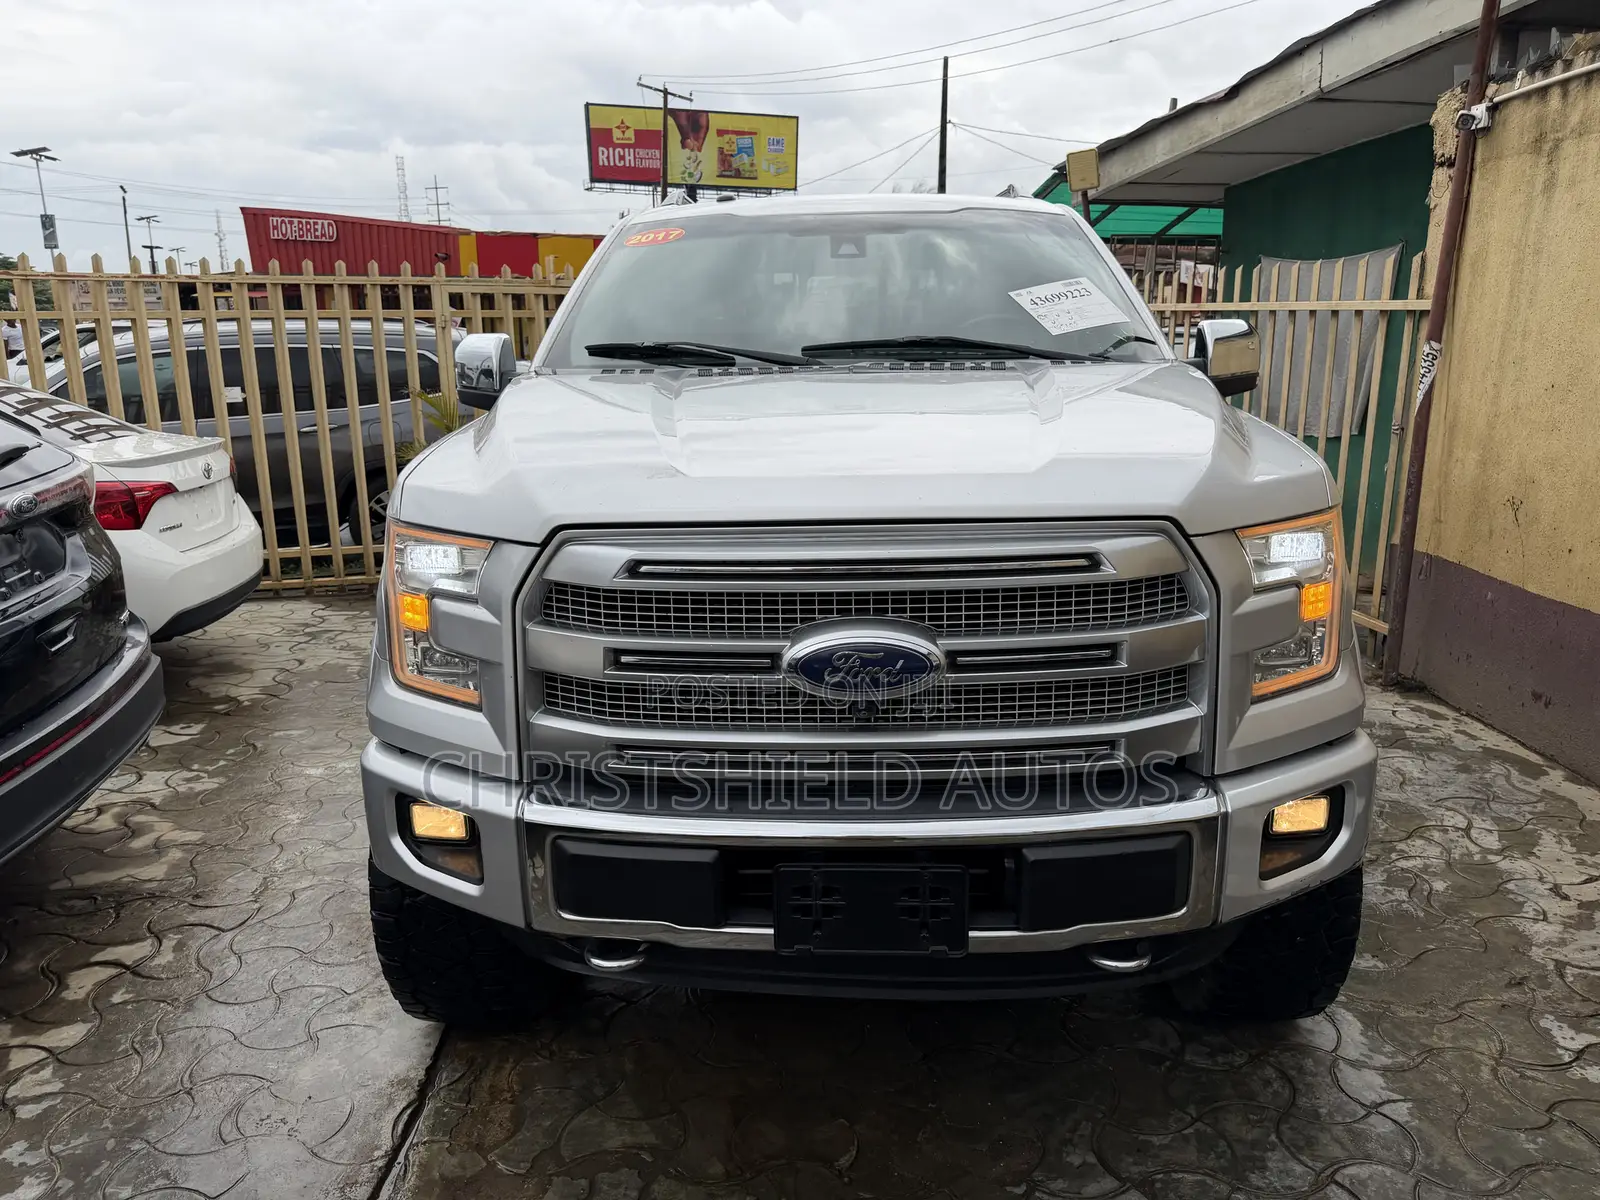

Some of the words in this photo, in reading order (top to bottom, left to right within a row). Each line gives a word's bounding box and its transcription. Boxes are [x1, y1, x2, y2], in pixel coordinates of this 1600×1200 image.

[767, 137, 785, 147] GAME
[598, 146, 635, 167] RICH
[635, 148, 660, 159] CHICKEN
[636, 158, 661, 169] FLAVOUR
[296, 219, 337, 241] BREAD
[627, 230, 681, 245] 2017
[1029, 287, 1092, 307] 43699223
[824, 650, 905, 684] Ford
